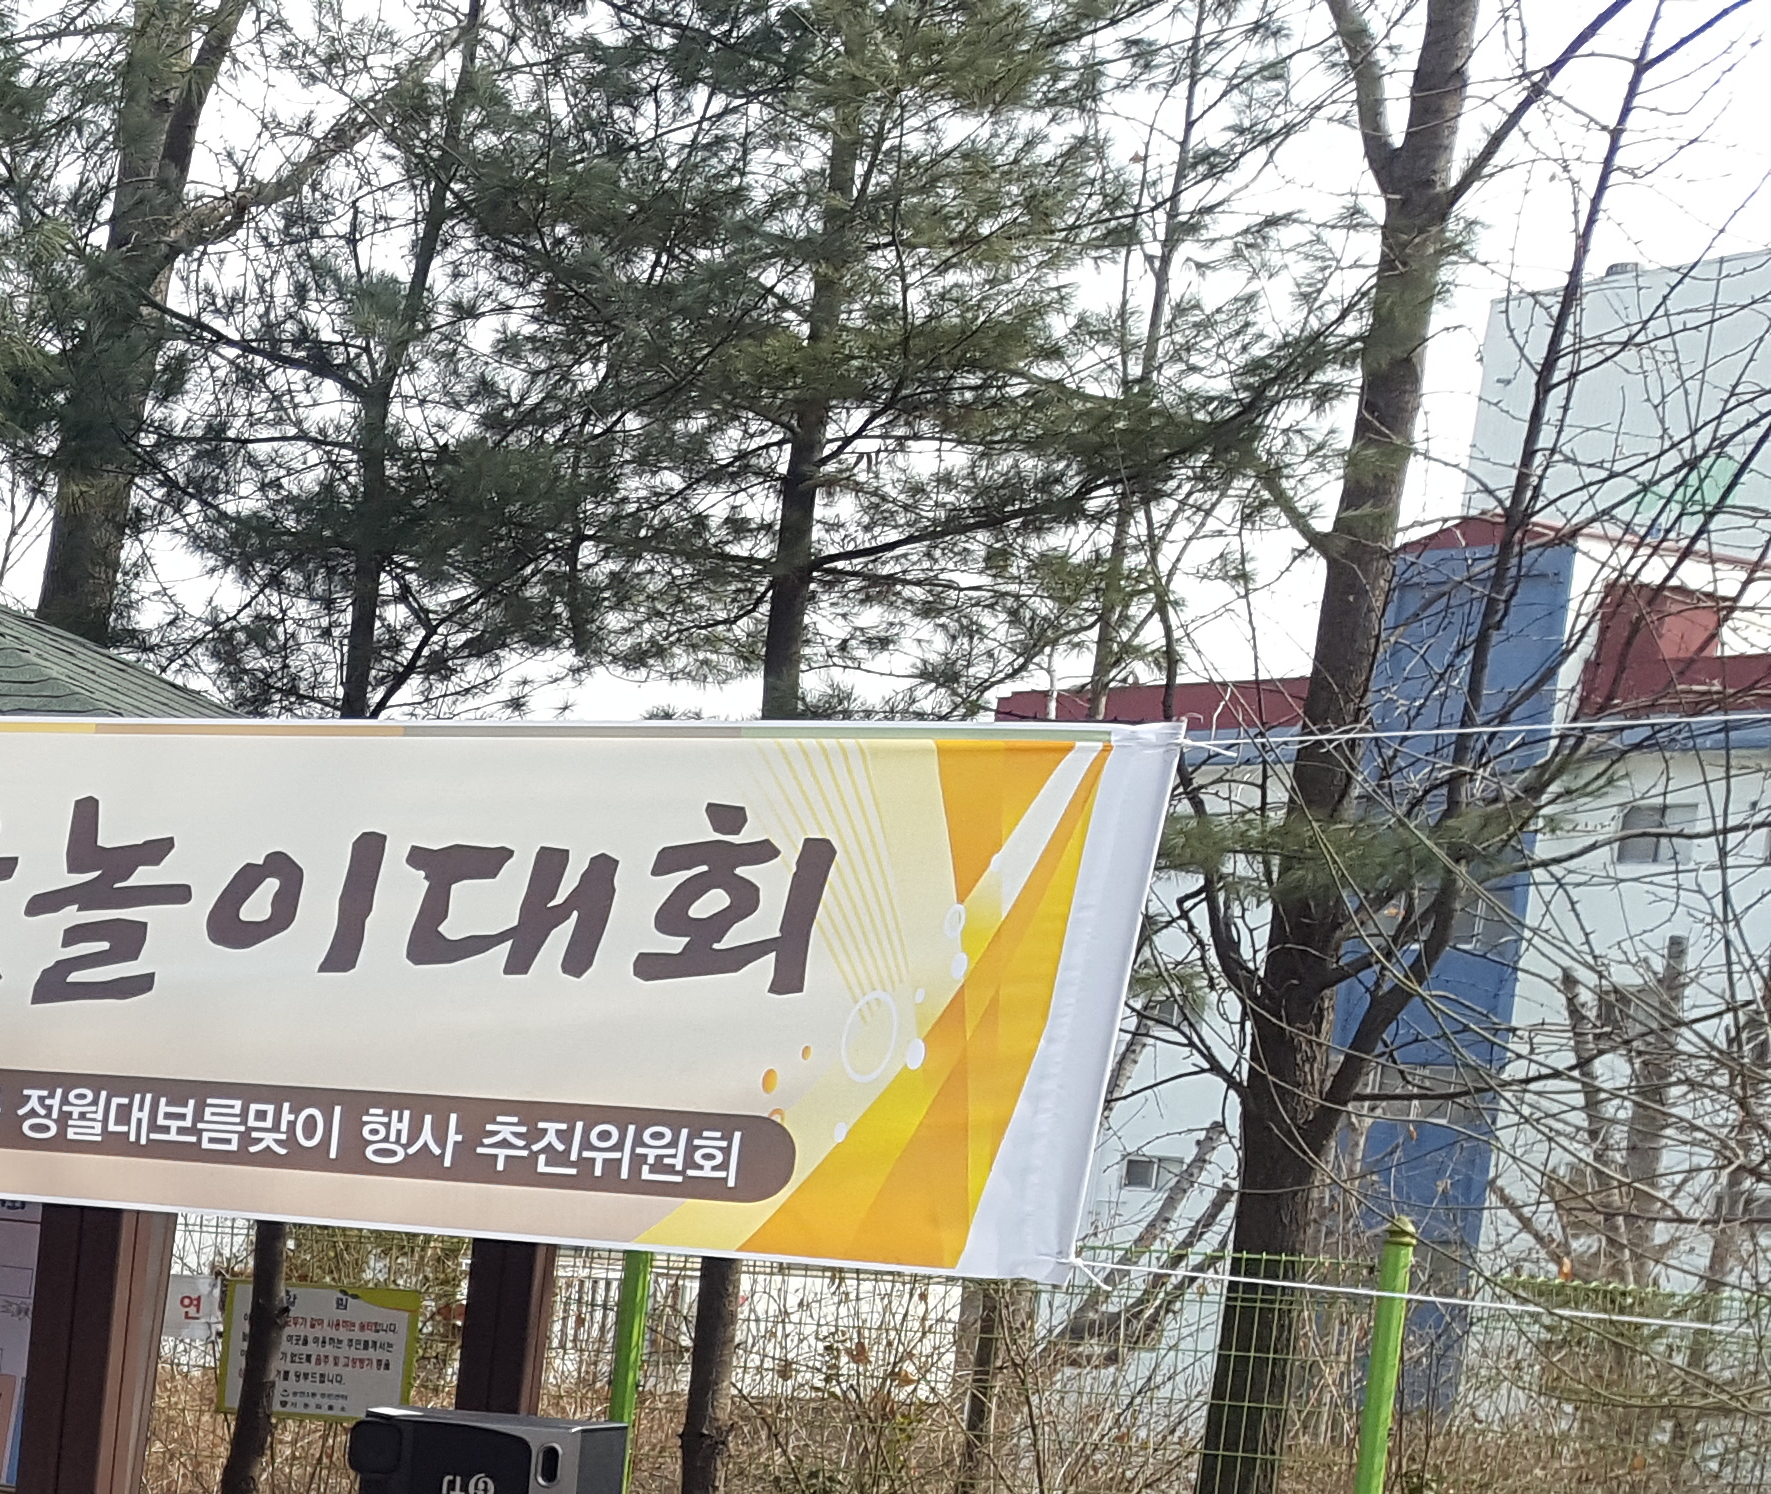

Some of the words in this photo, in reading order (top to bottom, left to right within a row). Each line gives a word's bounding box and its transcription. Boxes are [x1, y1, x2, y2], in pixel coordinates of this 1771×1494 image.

[16, 1085, 343, 1159] 정월대보름맞이
[360, 1107, 462, 1168] 행사
[475, 1115, 744, 1188] 추진위원회
